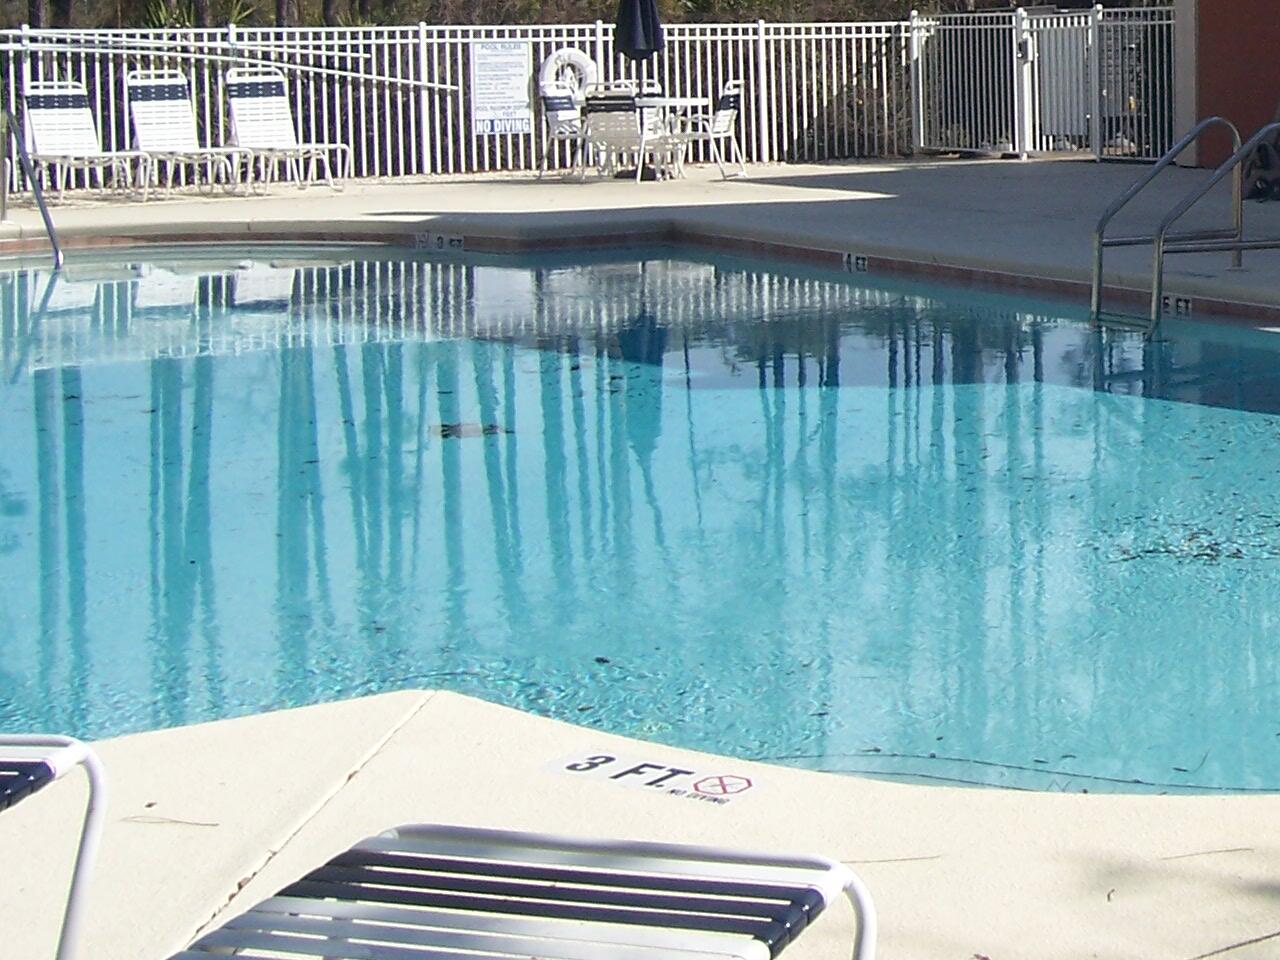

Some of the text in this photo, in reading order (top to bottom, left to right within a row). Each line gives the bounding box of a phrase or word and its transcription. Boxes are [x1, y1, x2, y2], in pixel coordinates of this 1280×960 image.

[476, 119, 530, 132] NO DIVING
[565, 755, 696, 788] 3 FT.
